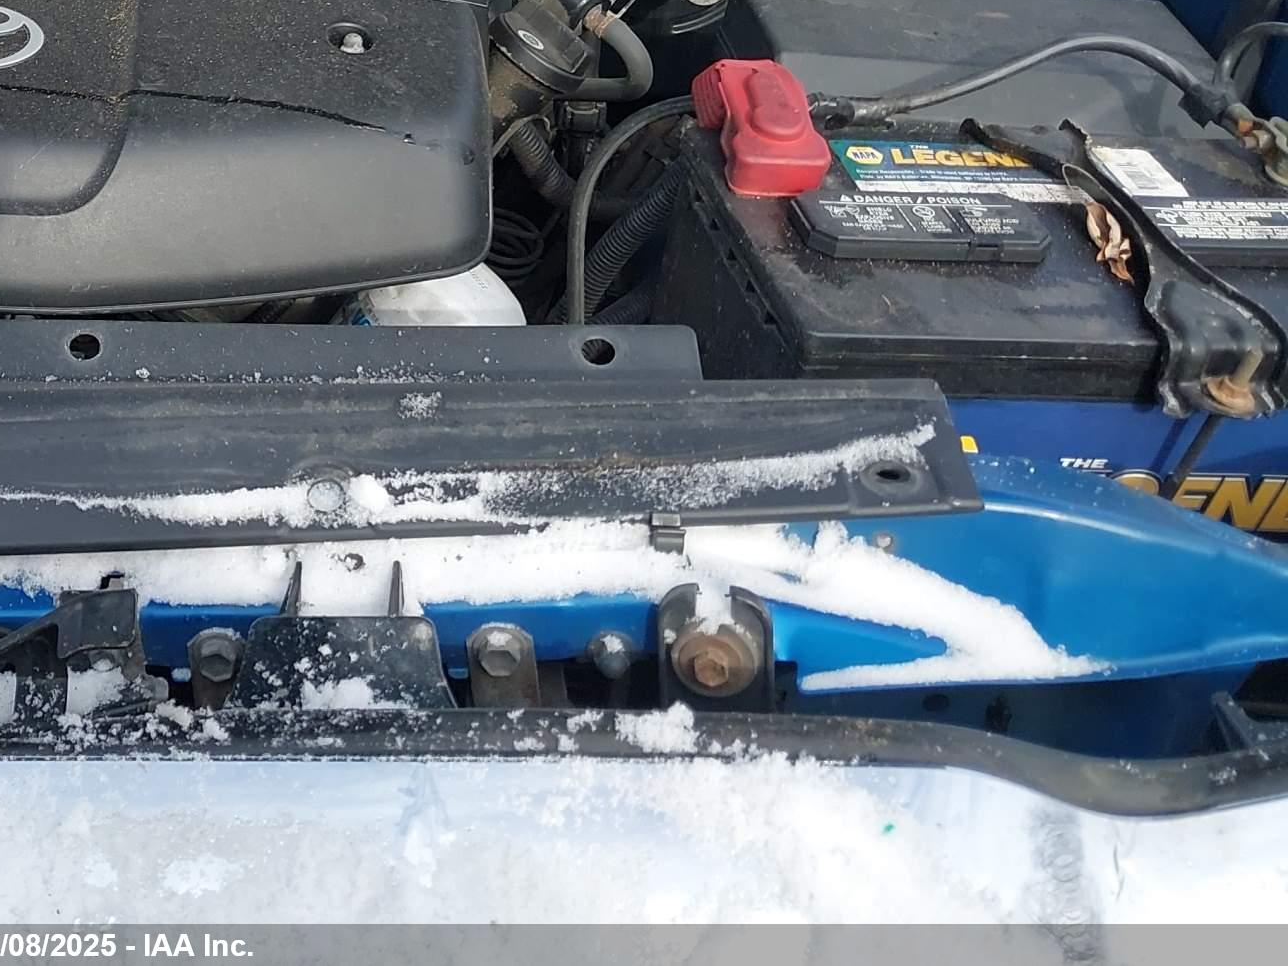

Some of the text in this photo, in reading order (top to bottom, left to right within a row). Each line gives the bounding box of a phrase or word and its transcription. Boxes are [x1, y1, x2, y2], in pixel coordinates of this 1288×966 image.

[851, 151, 879, 161] NAPA
[853, 194, 913, 204] DANGER
[926, 196, 982, 205] POISON
[1059, 457, 1109, 469] THE
